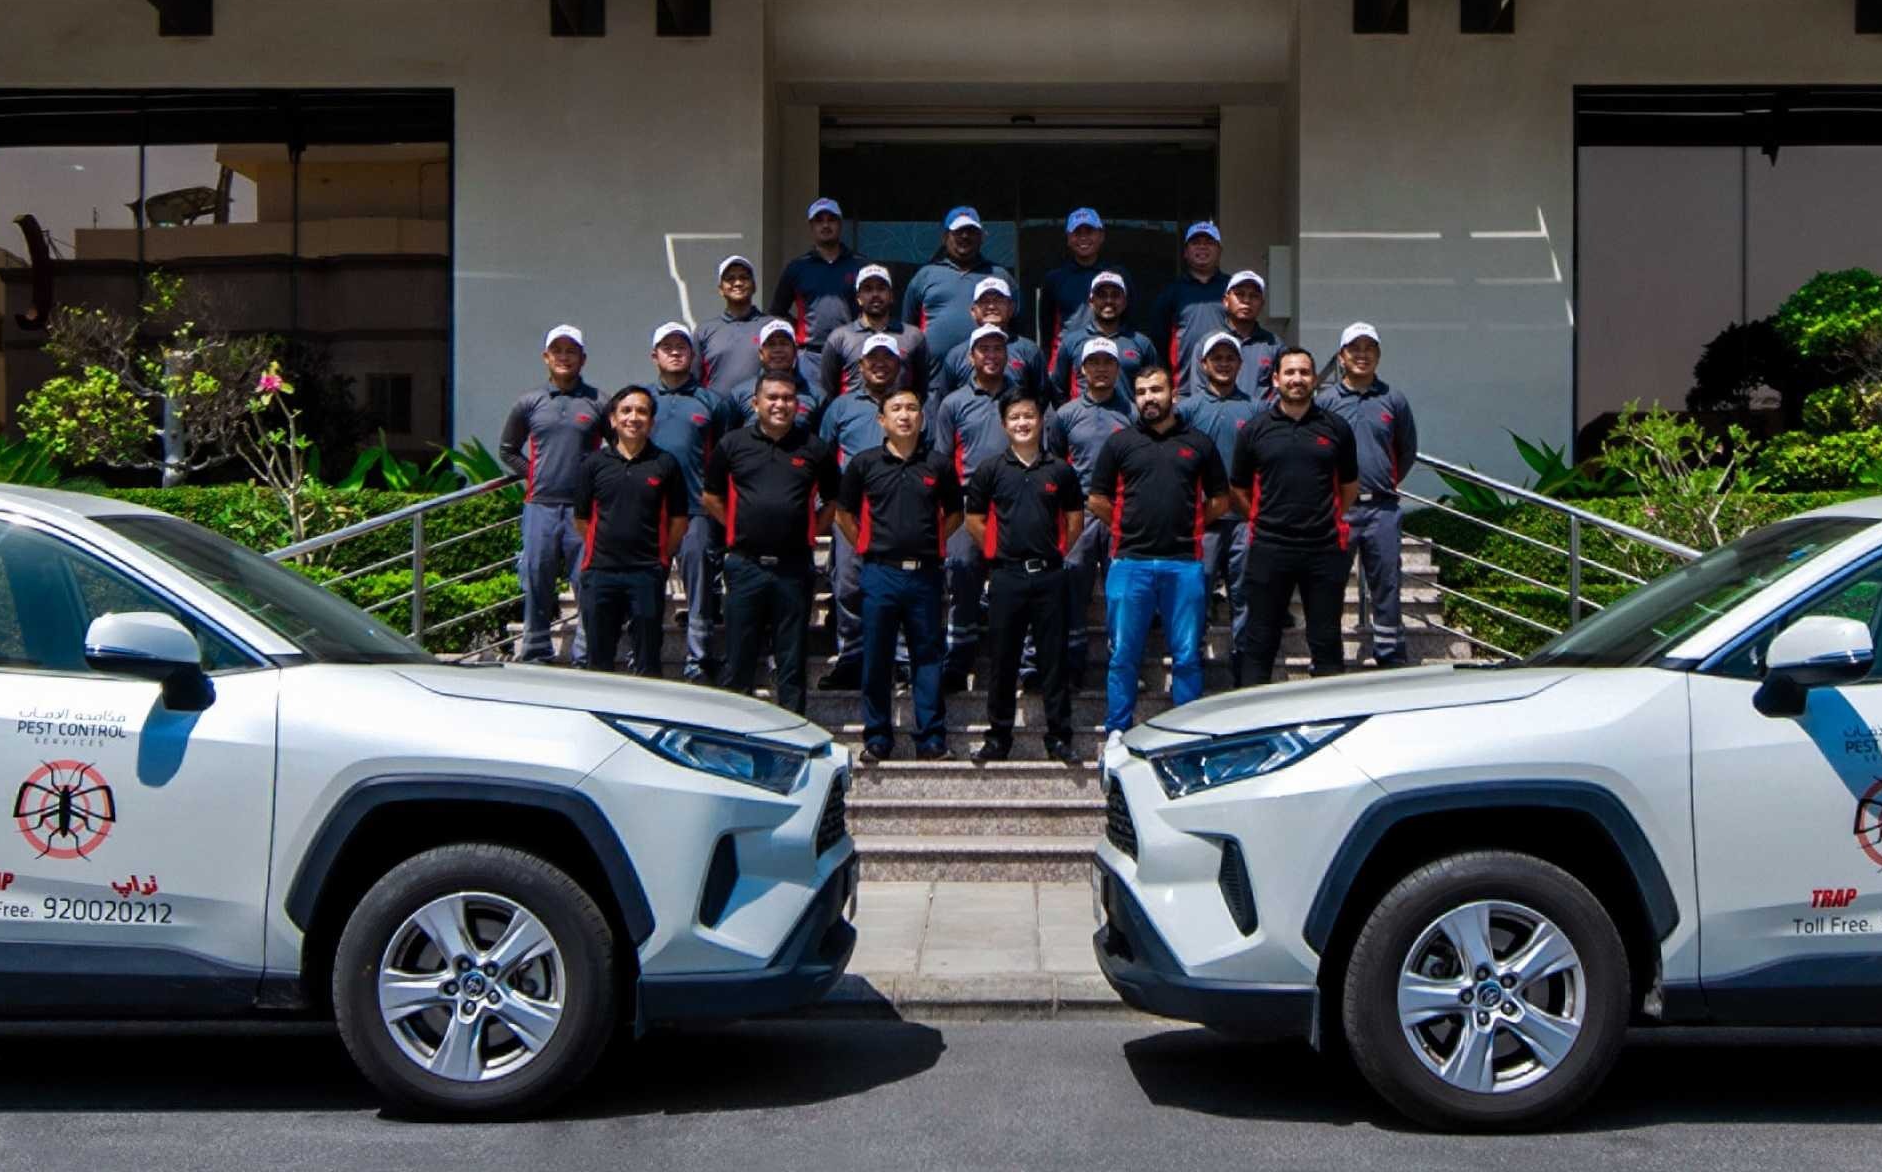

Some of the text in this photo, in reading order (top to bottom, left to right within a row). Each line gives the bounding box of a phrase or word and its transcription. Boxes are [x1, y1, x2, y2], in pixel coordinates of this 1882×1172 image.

[17, 719, 127, 739] PEST CONTROL
[1845, 739, 1879, 755] PEST
[1811, 887, 1858, 909] TRAP
[43, 897, 173, 924] 920020212
[1793, 917, 1825, 934] Toll
